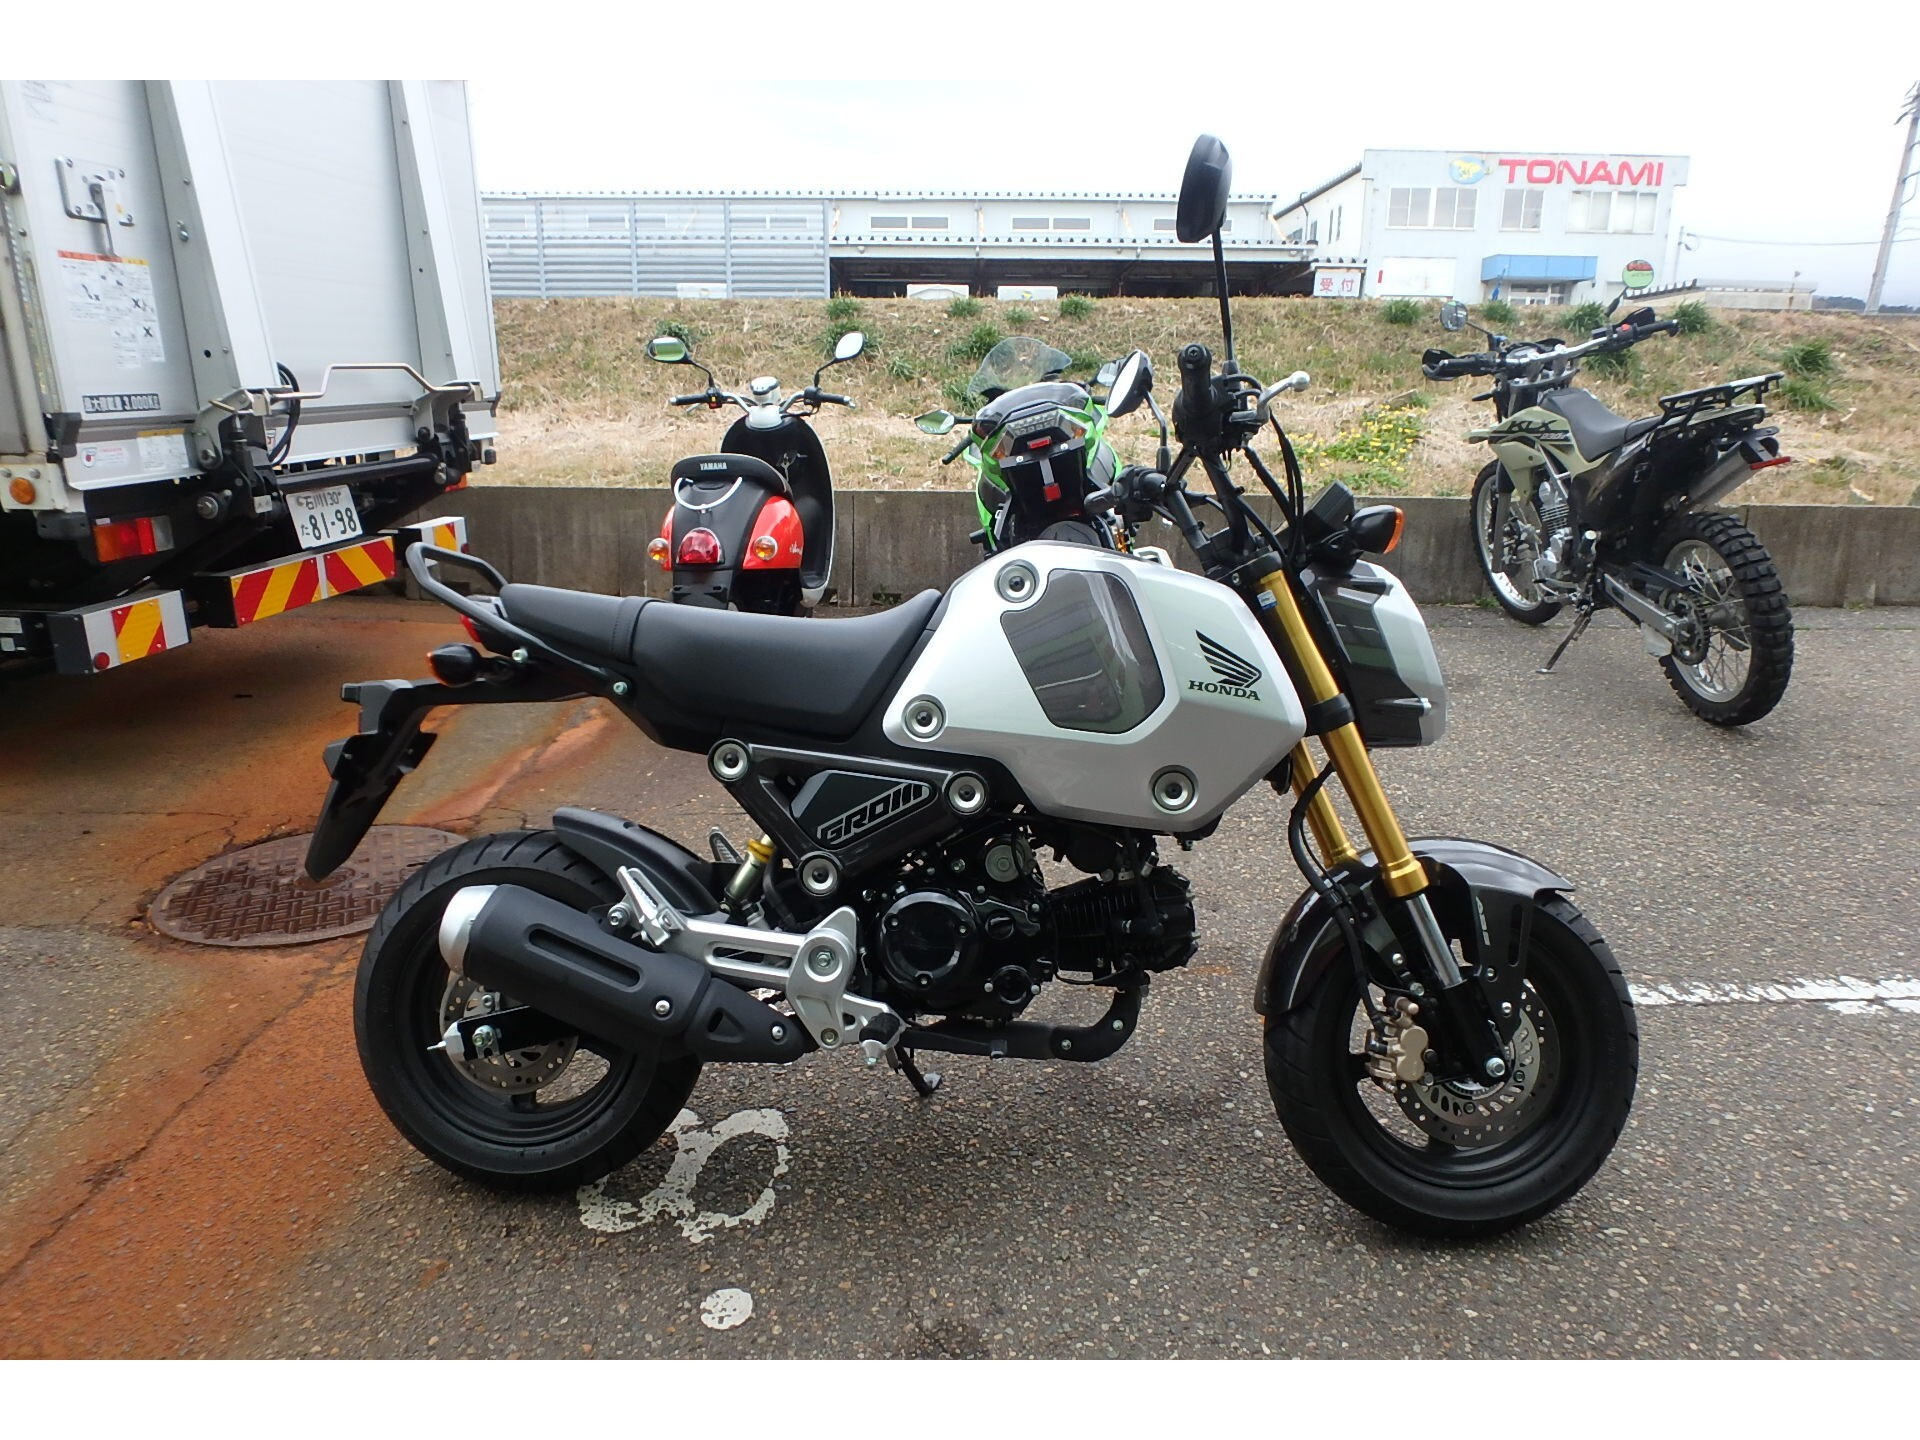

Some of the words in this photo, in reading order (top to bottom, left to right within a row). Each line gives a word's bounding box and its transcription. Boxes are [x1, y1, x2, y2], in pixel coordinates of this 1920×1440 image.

[1498, 159, 1664, 187] TONAMI
[1319, 277, 1355, 293] 受付
[1506, 419, 1557, 433] KLX
[700, 462, 728, 471] YAMAHA
[308, 507, 357, 541] 81-98
[1187, 680, 1262, 702] HONDA
[818, 783, 926, 844] GROM
